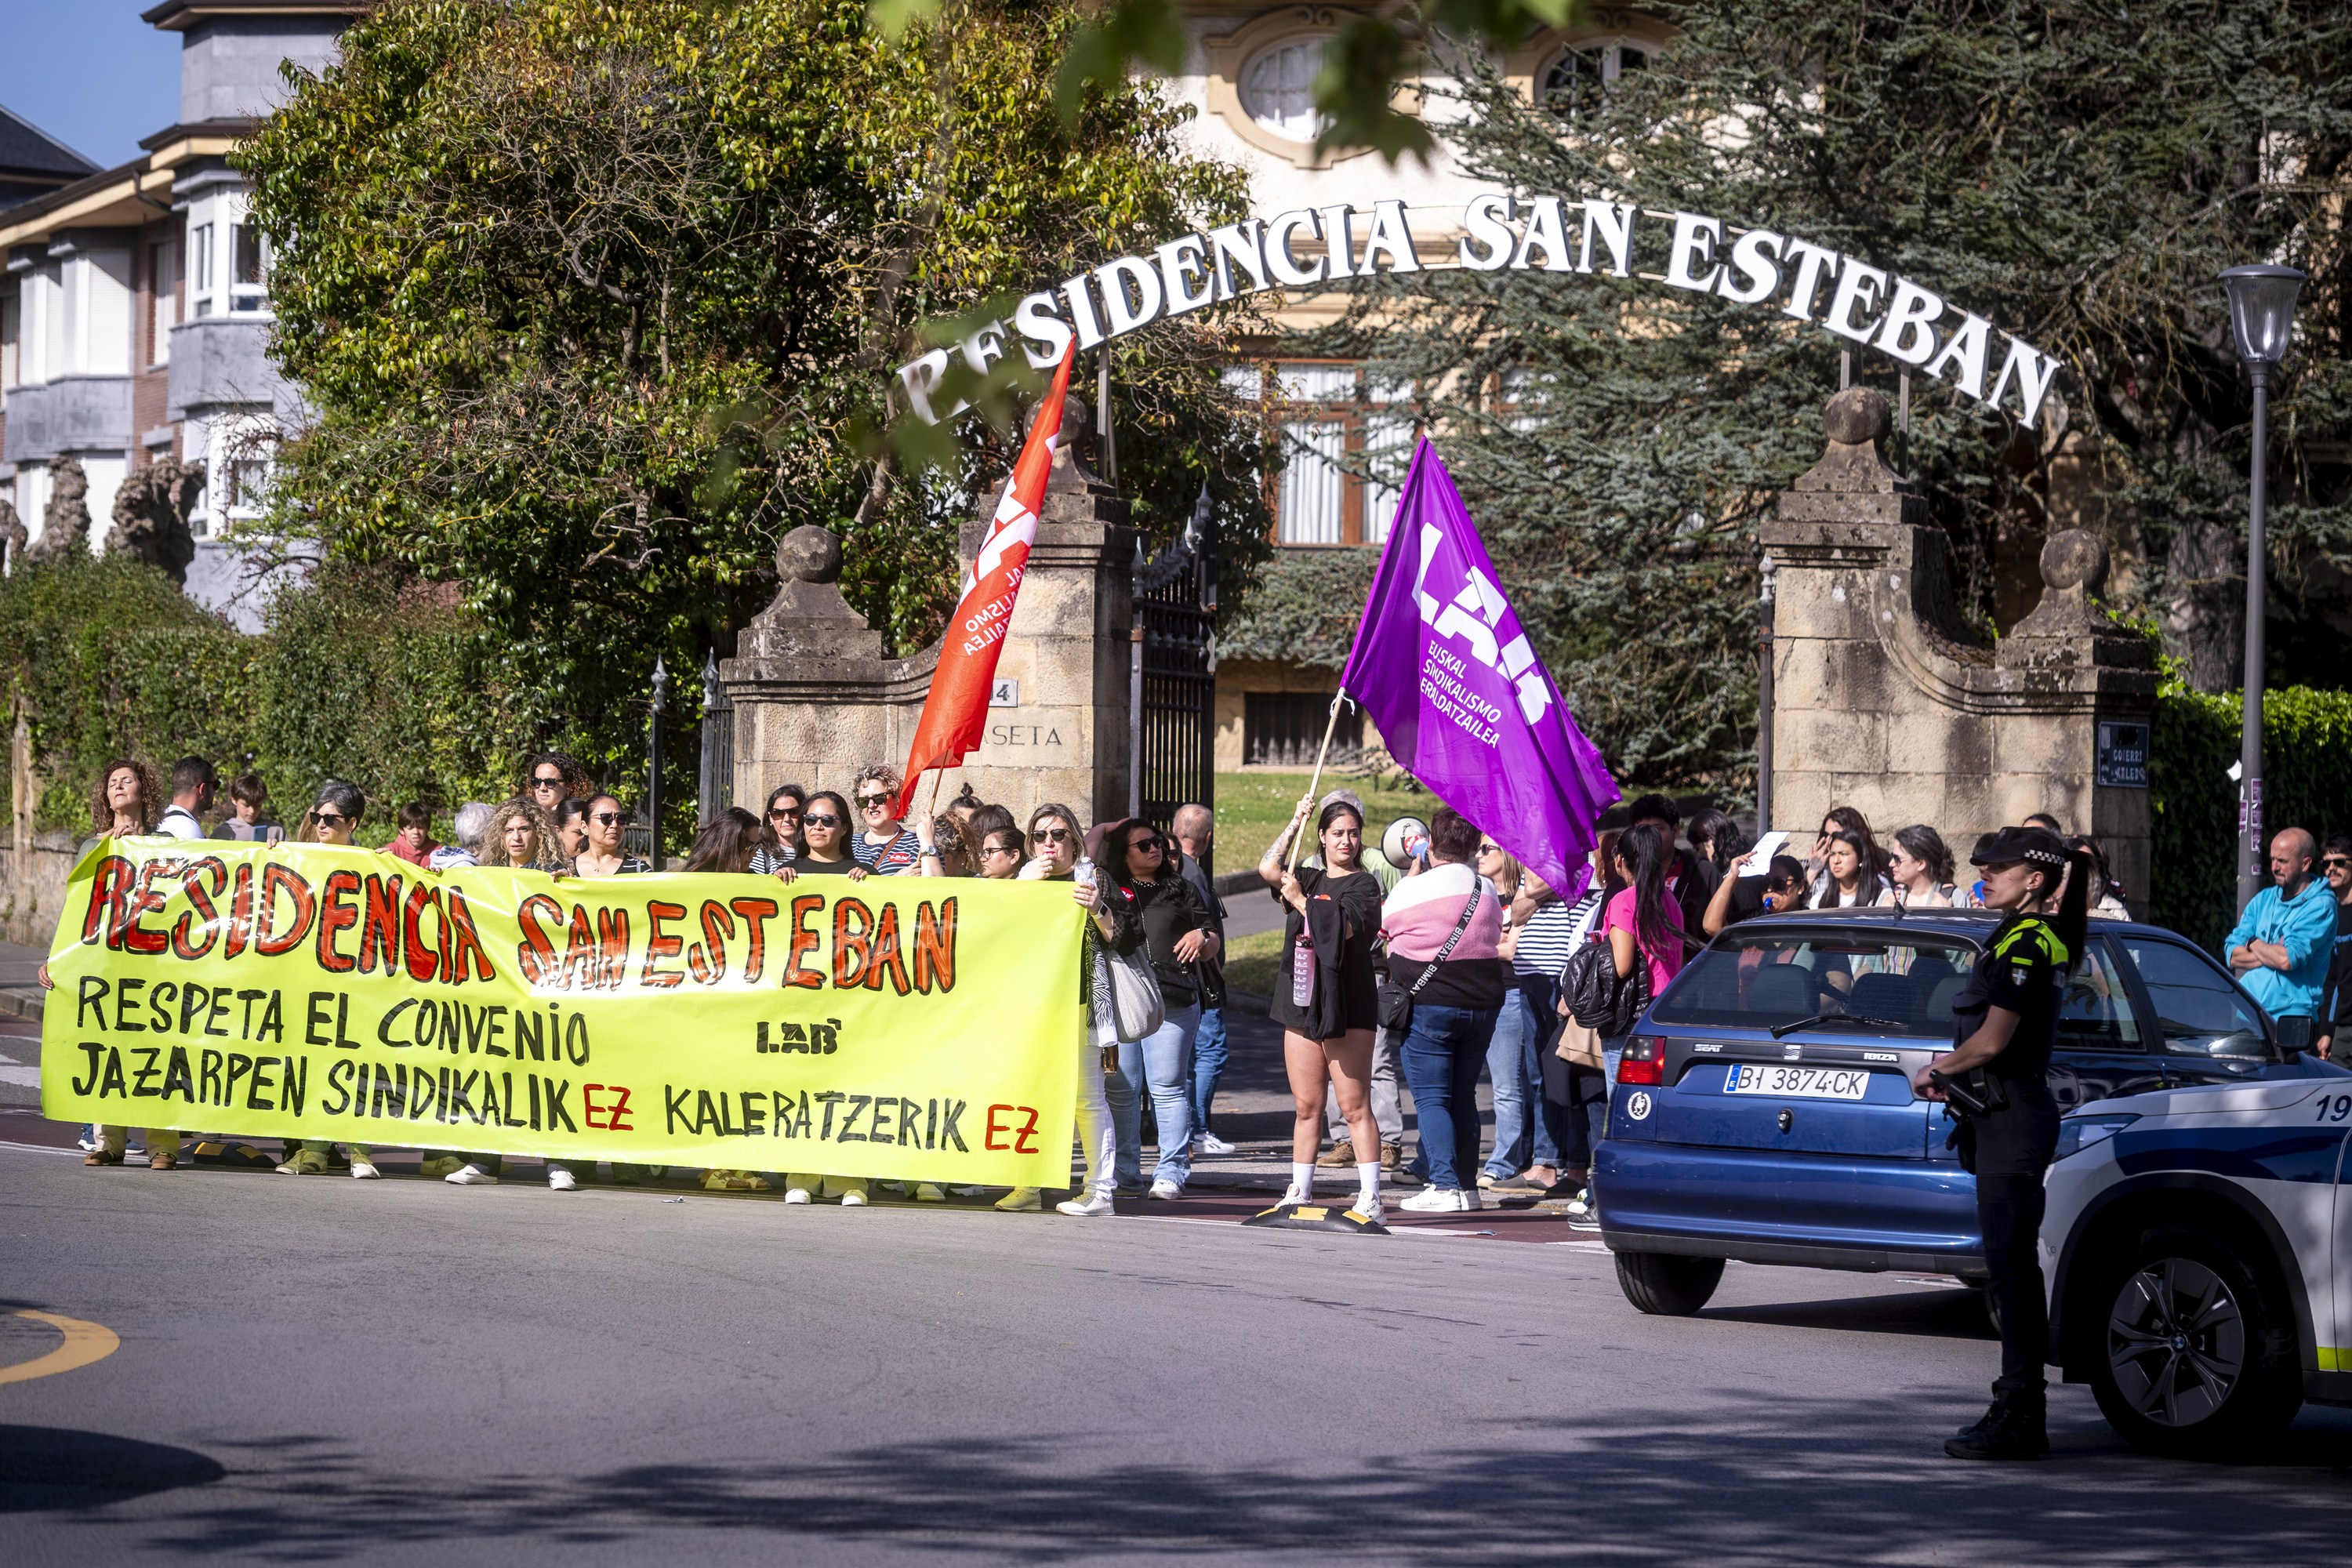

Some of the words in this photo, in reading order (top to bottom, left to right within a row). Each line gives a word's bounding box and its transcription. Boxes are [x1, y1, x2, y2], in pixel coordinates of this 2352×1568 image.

[897, 200, 1421, 426] RESIDENCIA
[1459, 194, 1637, 279] SAN
[1663, 209, 2063, 431] ESTEBAN
[1428, 639, 1467, 680] EUSKAL
[1422, 659, 1502, 723] SINDIKALISMO
[1420, 677, 1501, 749] ERALDATZAILEA
[81, 855, 496, 985] RESIDENCIA
[517, 893, 630, 992] SAN
[640, 894, 958, 997] ESTEBAN
[1462, 887, 1480, 924] BIMBAY
[1438, 927, 1463, 962] BIMBAY
[1410, 964, 1437, 996] BIMBAY
[77, 975, 285, 1045] RESPETA
[306, 991, 361, 1050] EL
[1693, 1044, 1724, 1053] SEAT
[1863, 1052, 1899, 1062] IBIZA
[72, 1041, 307, 1118] JAZARPEN
[321, 1058, 578, 1134] SINDIKALIK
[583, 1083, 634, 1131] EZ
[664, 1083, 970, 1153] KALERATZERIK
[984, 1102, 1040, 1154] EZ
[2316, 1094, 2352, 1122] 19
